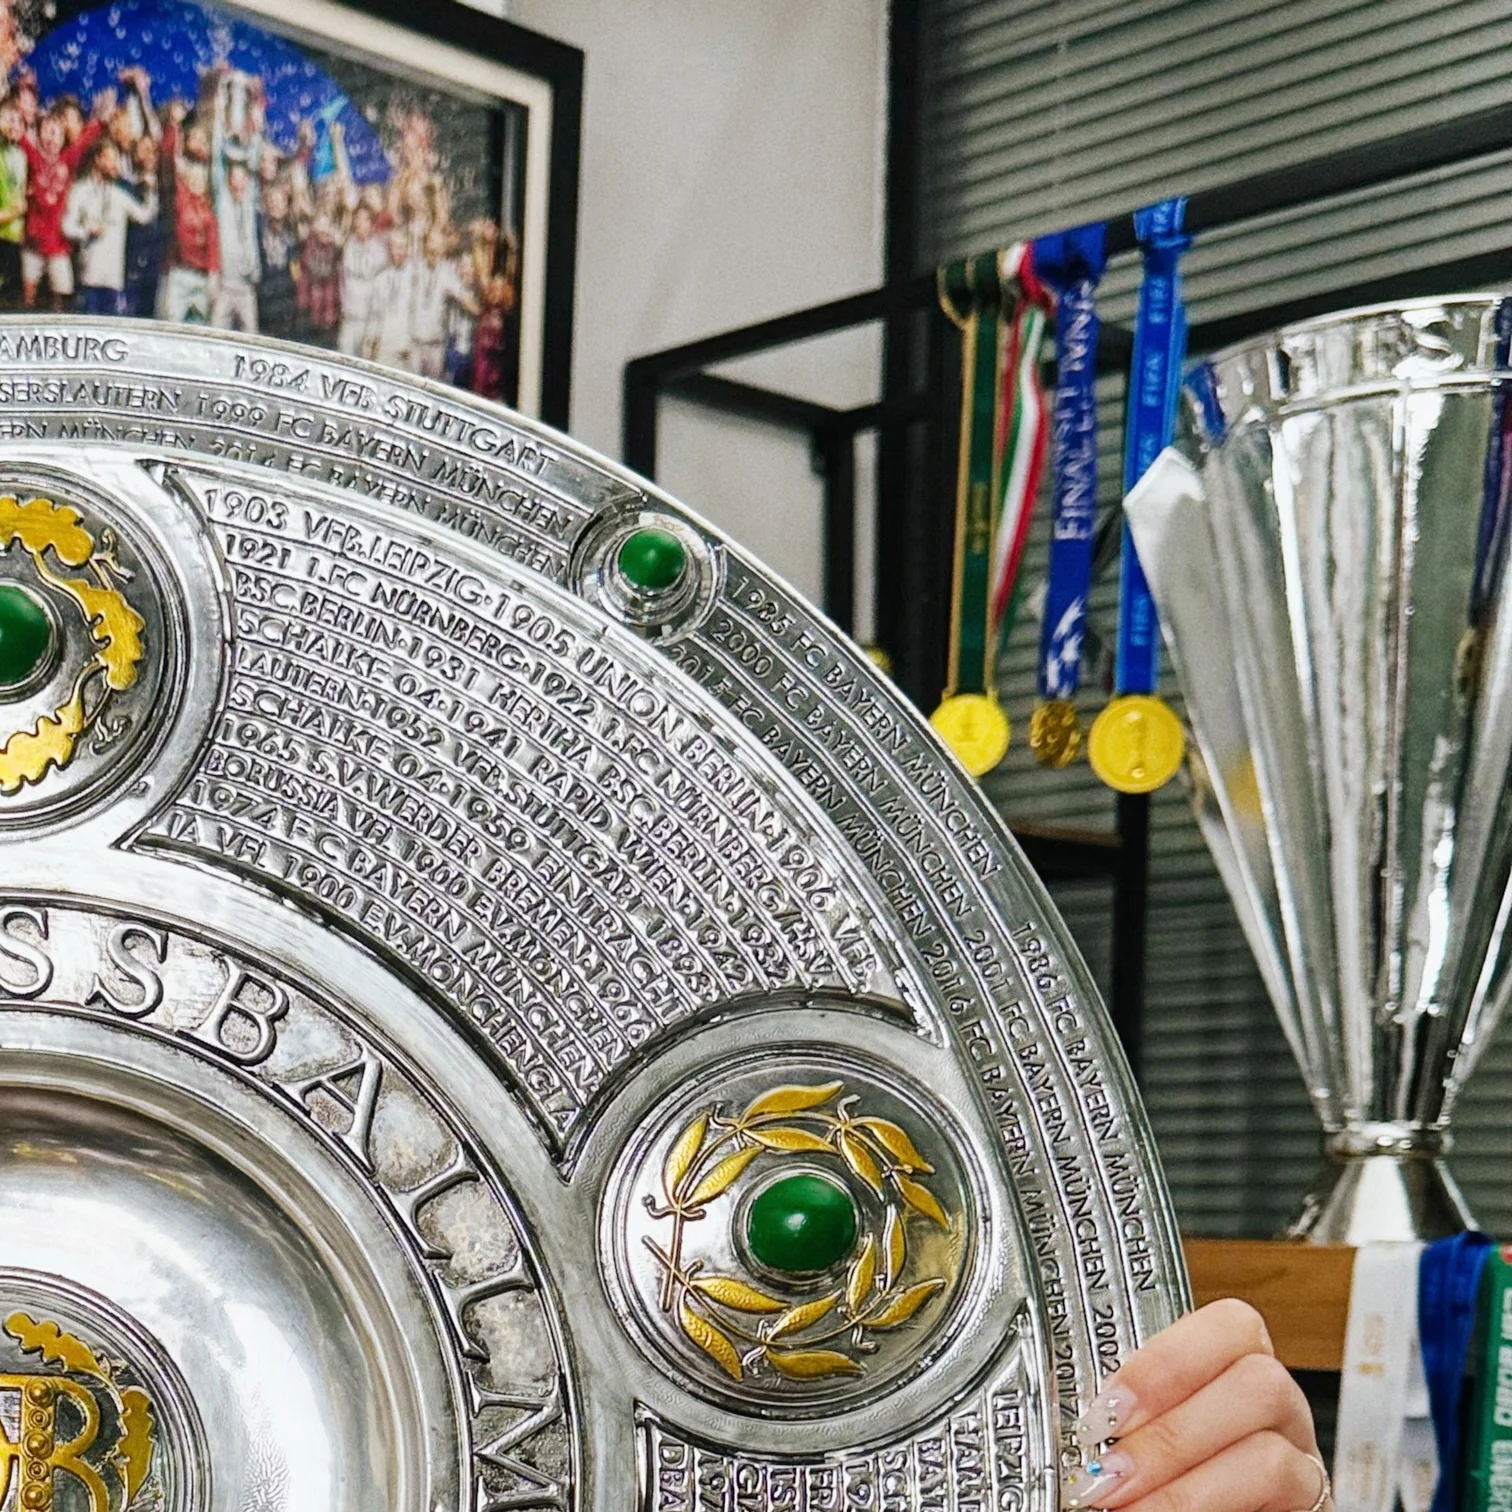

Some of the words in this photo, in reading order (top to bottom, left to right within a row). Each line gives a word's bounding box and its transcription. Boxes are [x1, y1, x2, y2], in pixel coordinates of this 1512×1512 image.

[194, 392, 267, 430] 1999
[274, 408, 315, 440] FC
[318, 415, 428, 476] BAYERN
[432, 451, 575, 542] MÜNCHEN
[231, 353, 311, 395] 1984
[383, 387, 557, 485] STUTTGART
[707, 616, 777, 682] 2000
[768, 672, 809, 713] FC
[800, 703, 889, 798] BAYERN
[875, 786, 984, 922] MÜNCHEN
[728, 576, 795, 638] 1985
[788, 631, 828, 670] FC
[820, 660, 912, 756] BAYERN
[898, 745, 1009, 880] MÜNCHEN
[918, 940, 976, 1015] 2016
[961, 927, 1012, 994] 2001
[1007, 919, 1063, 993] 1986
[958, 1017, 997, 1062] FC
[997, 1000, 1033, 1041] FC
[1043, 994, 1080, 1036] FC
[975, 1063, 1042, 1177] BAYERN
[1014, 1041, 1076, 1146] BAYERN
[1061, 1036, 1123, 1144] BAYERN
[1052, 1147, 1122, 1296] MÜNCHEN
[1100, 1146, 1167, 1294] MÜNCHEN
[1089, 1303, 1125, 1376] 2002
